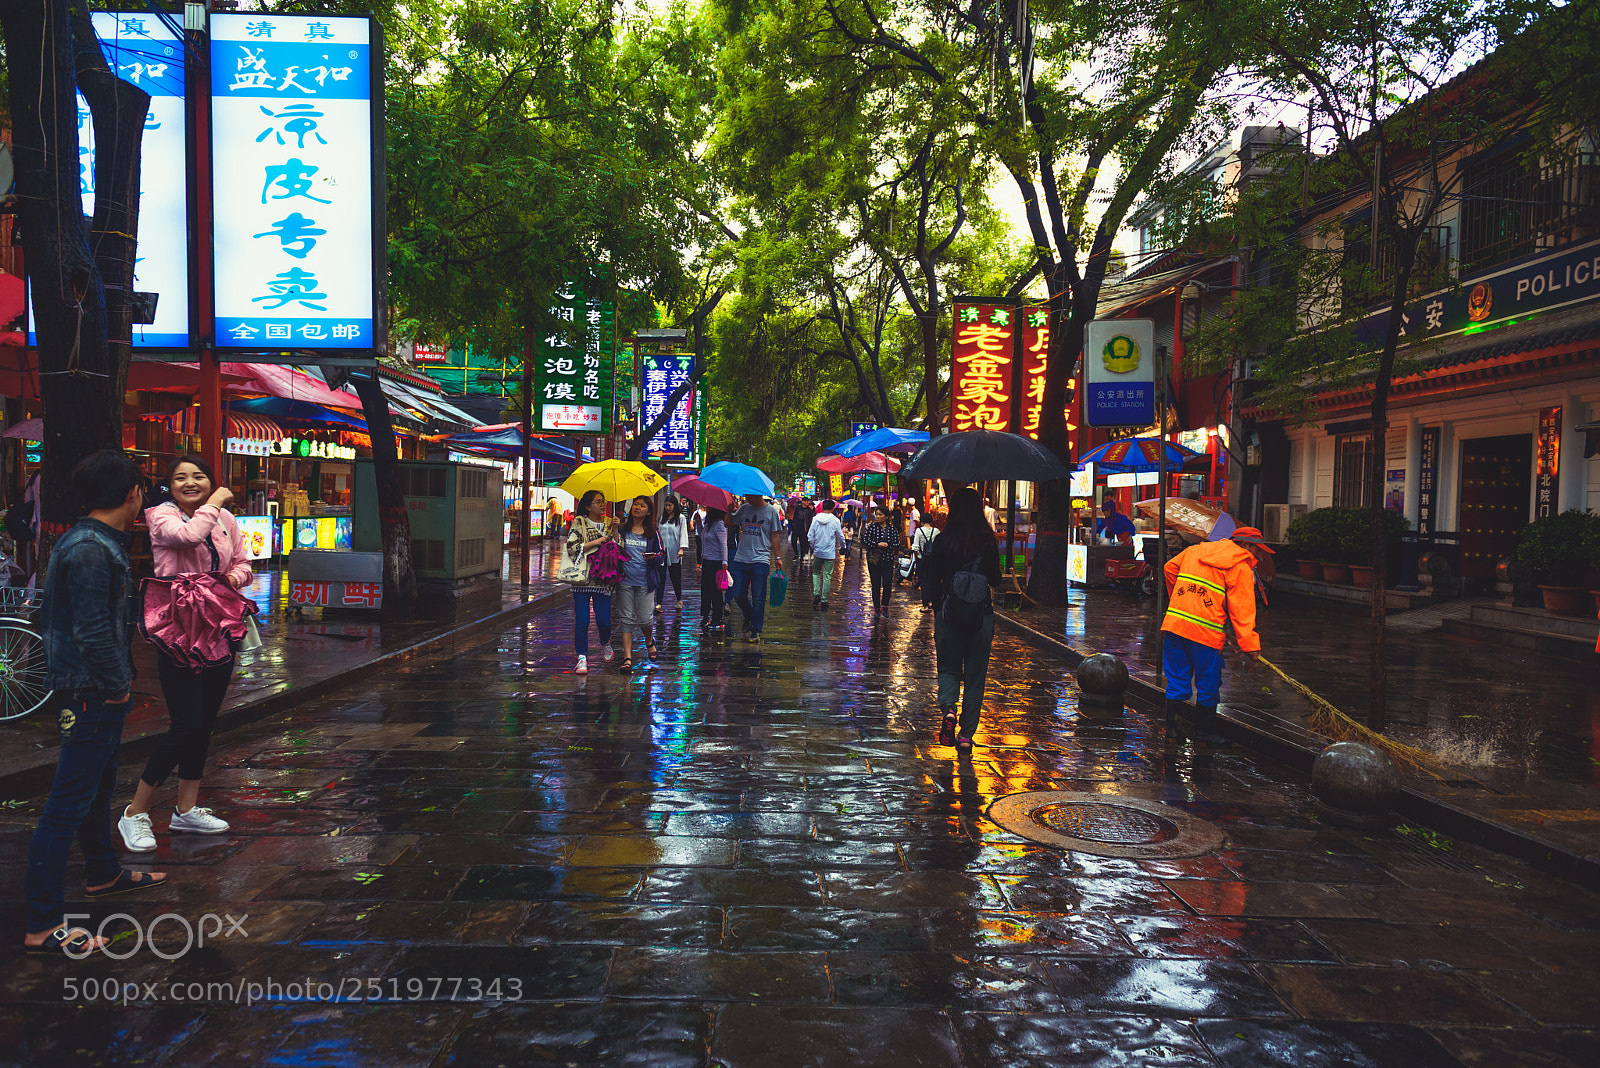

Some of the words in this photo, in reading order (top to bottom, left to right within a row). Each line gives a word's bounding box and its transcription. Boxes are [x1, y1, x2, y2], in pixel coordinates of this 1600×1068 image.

[245, 20, 335, 40] 清真
[229, 45, 354, 94] 盛天和
[251, 104, 332, 312] 凉皮专卖
[959, 306, 1010, 326] 清真
[228, 323, 361, 342] 全国包邮
[1097, 389, 1145, 399] 公安派出所
[1096, 401, 1118, 409] POLICE
[1120, 401, 1145, 409] STATION
[564, 413, 580, 421] 小吃
[583, 413, 598, 421] 炒菜
[1539, 474, 1551, 518] 北院门
